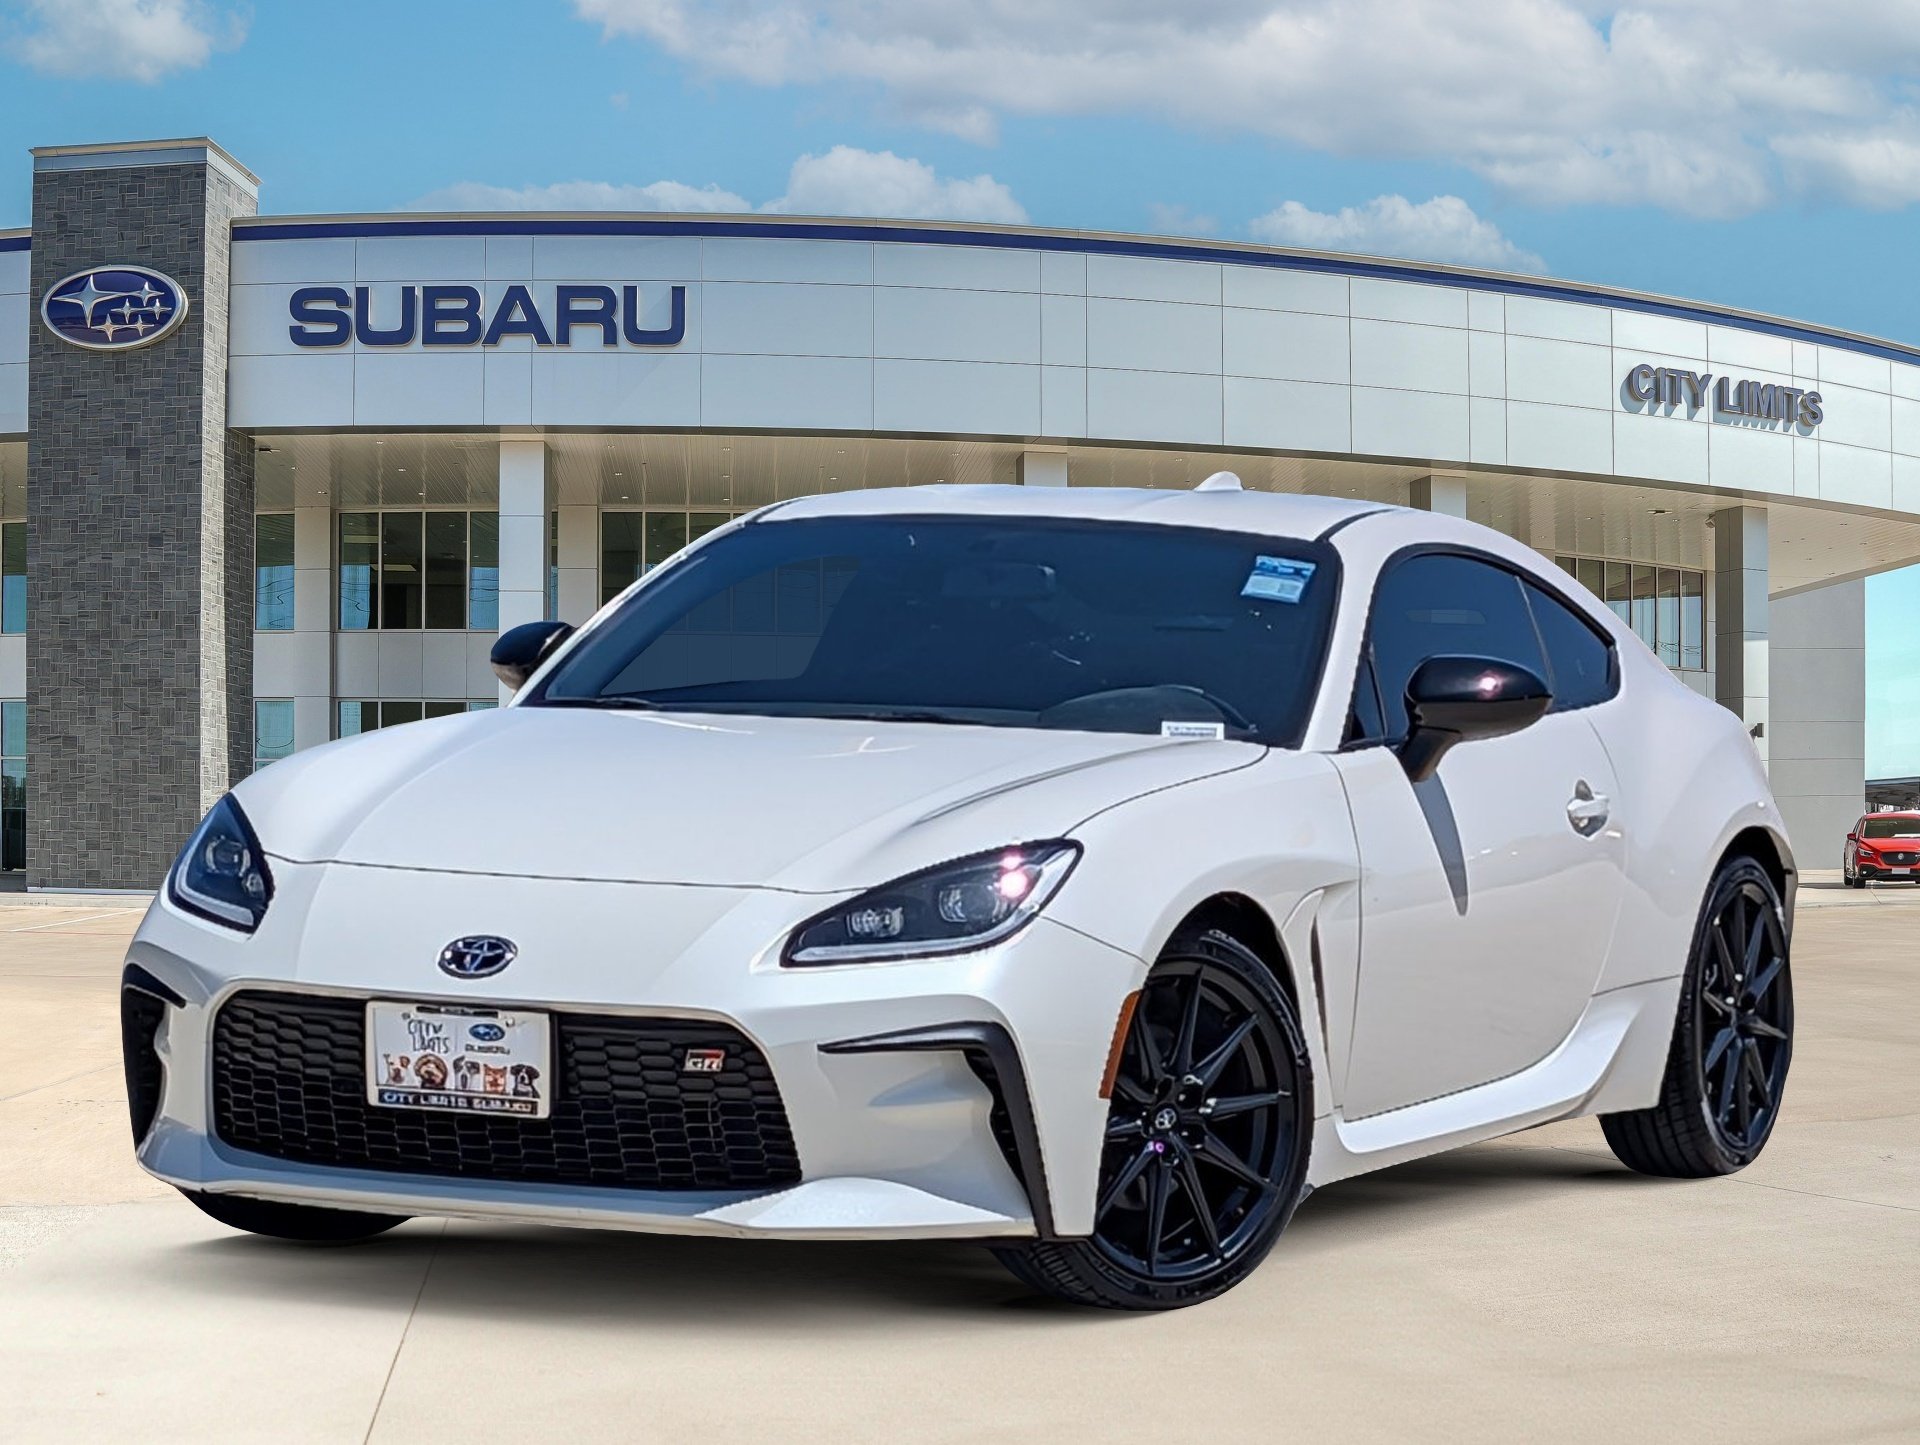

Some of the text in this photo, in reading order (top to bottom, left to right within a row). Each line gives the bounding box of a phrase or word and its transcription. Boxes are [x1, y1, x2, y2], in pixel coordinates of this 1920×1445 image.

[289, 285, 687, 347] SUBARU
[1630, 363, 1824, 427] CITY LIMITS
